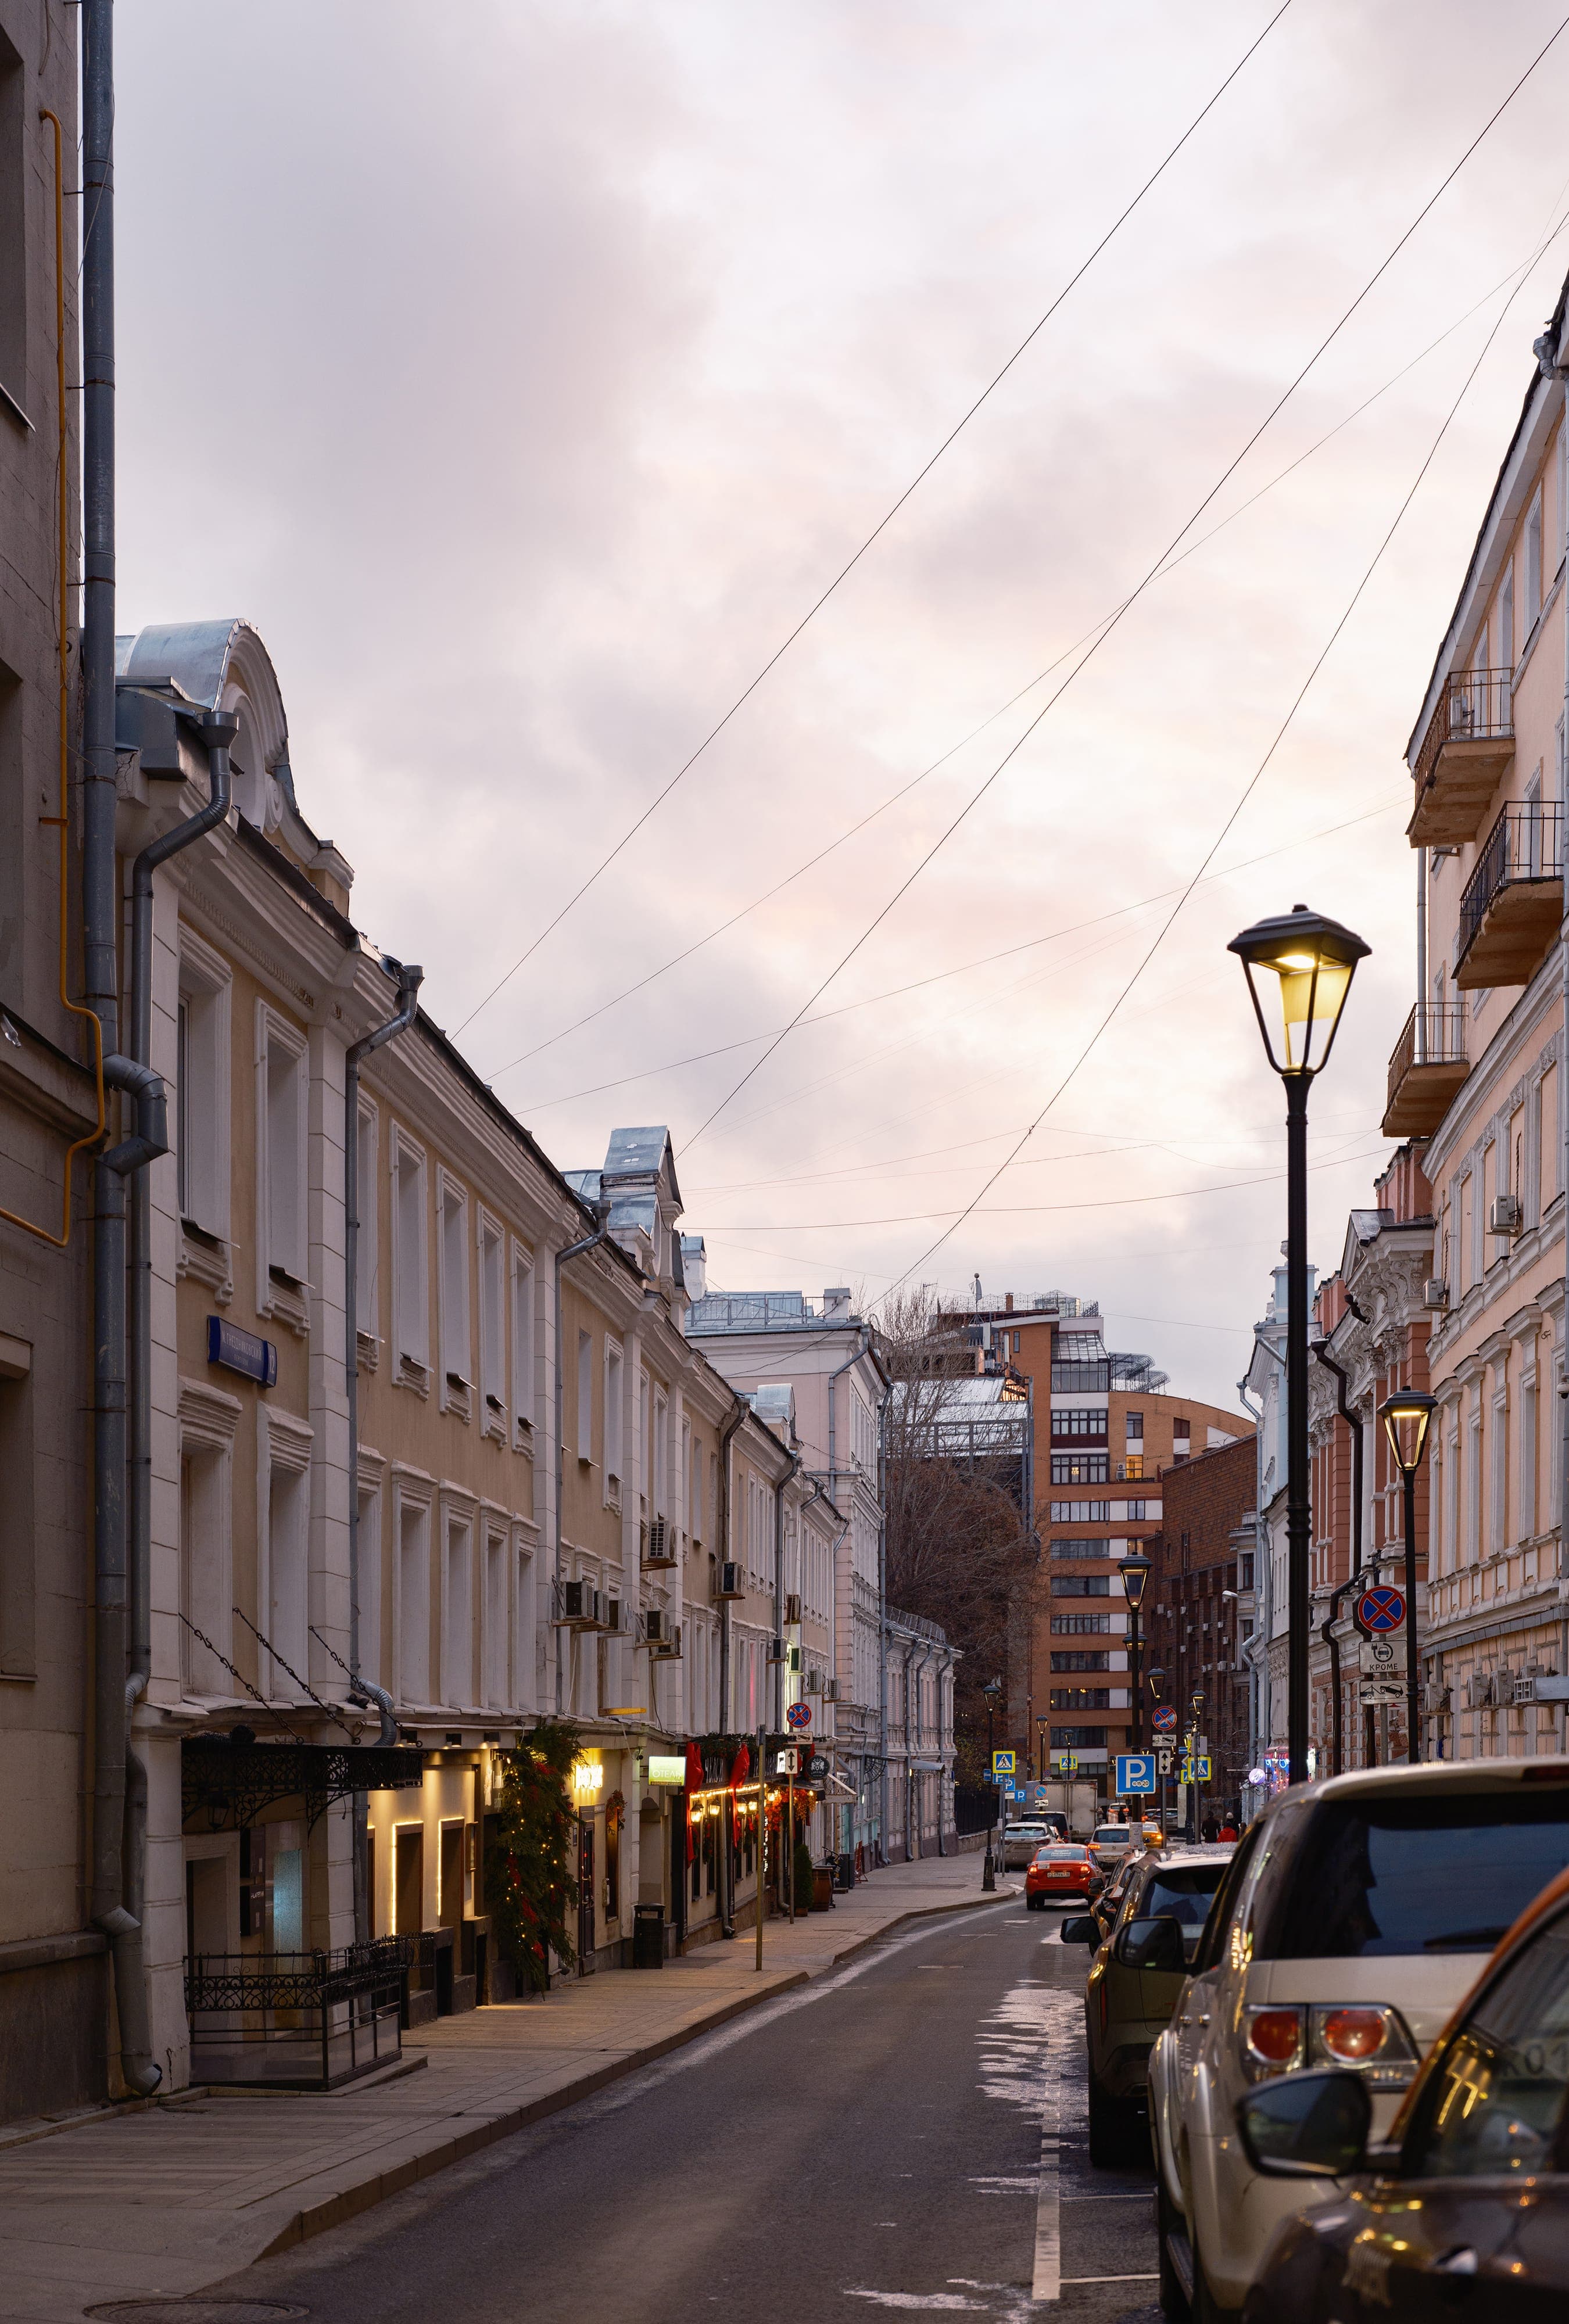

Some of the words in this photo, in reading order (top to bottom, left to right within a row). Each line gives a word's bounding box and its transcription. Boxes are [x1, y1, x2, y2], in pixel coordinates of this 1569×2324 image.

[270, 1355, 274, 1374] 12
[652, 1770, 682, 1778] ОТЕЛЬ
[1126, 1759, 1146, 1788] P
